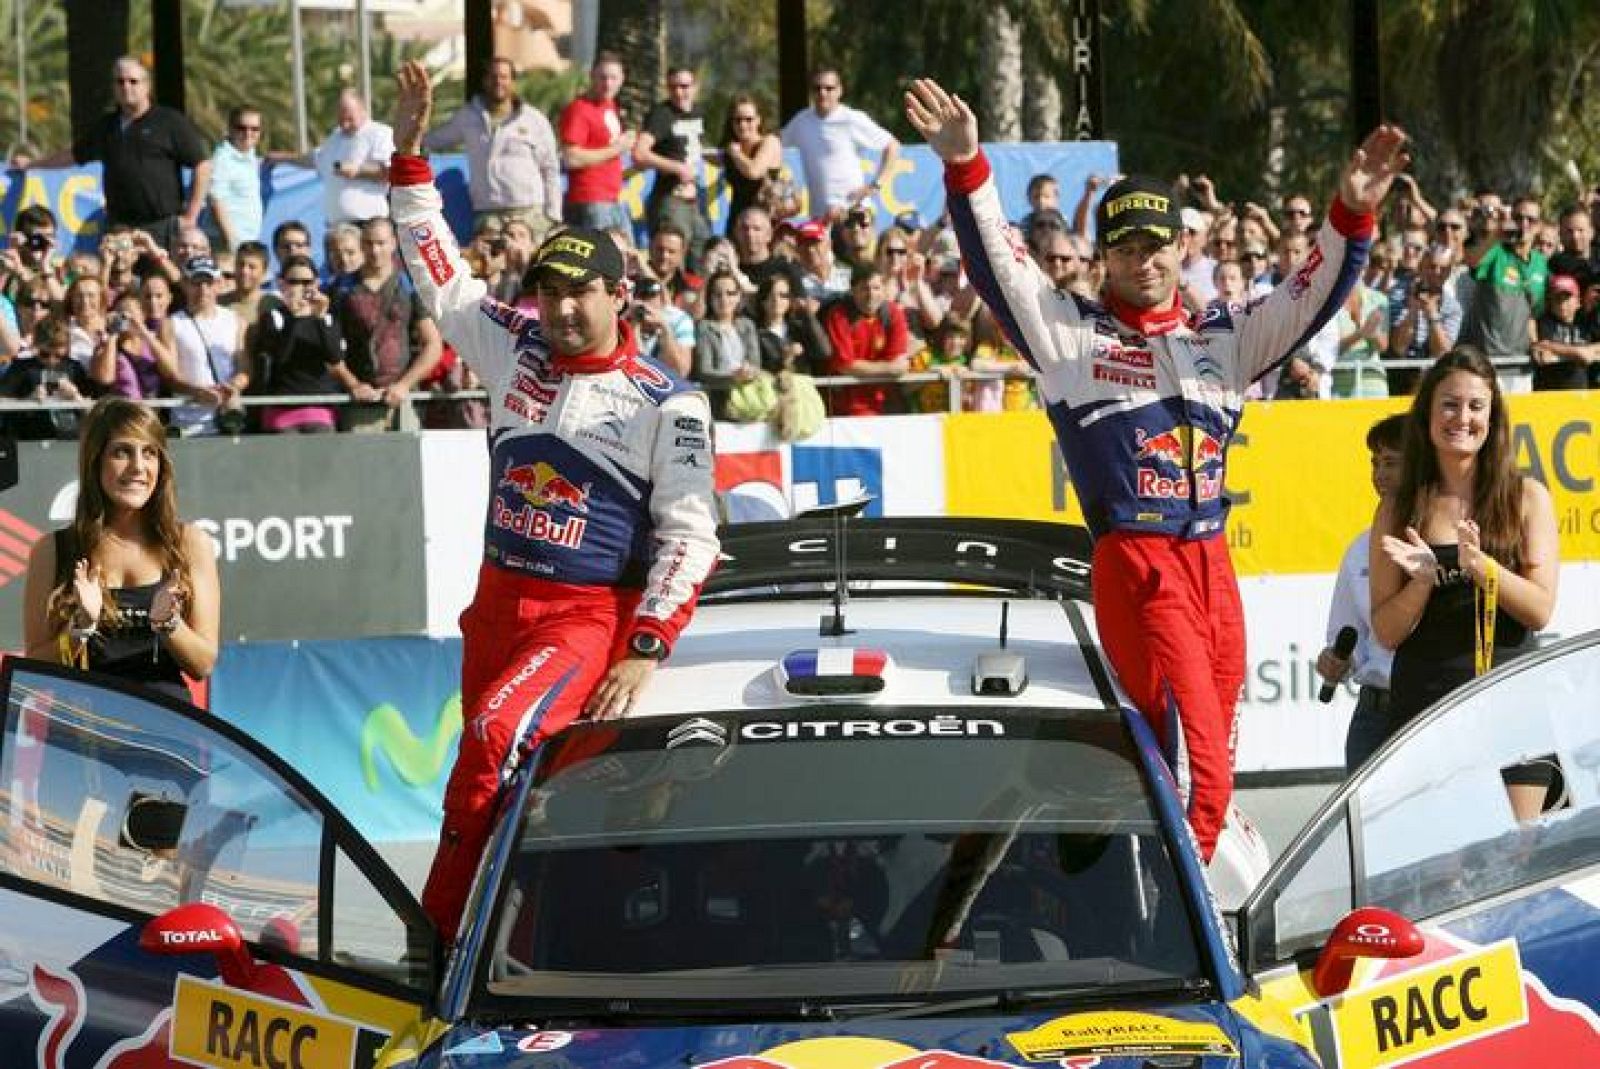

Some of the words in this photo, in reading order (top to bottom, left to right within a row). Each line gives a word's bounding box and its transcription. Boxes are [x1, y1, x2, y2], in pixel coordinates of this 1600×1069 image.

[1136, 467, 1191, 499] Red
[195, 514, 354, 562] SPORT
[526, 508, 588, 550] Bull
[741, 714, 1006, 739] CITROËN
[159, 928, 223, 944] TOTAL
[1371, 966, 1488, 1053] RACC
[206, 999, 318, 1069] RACC
